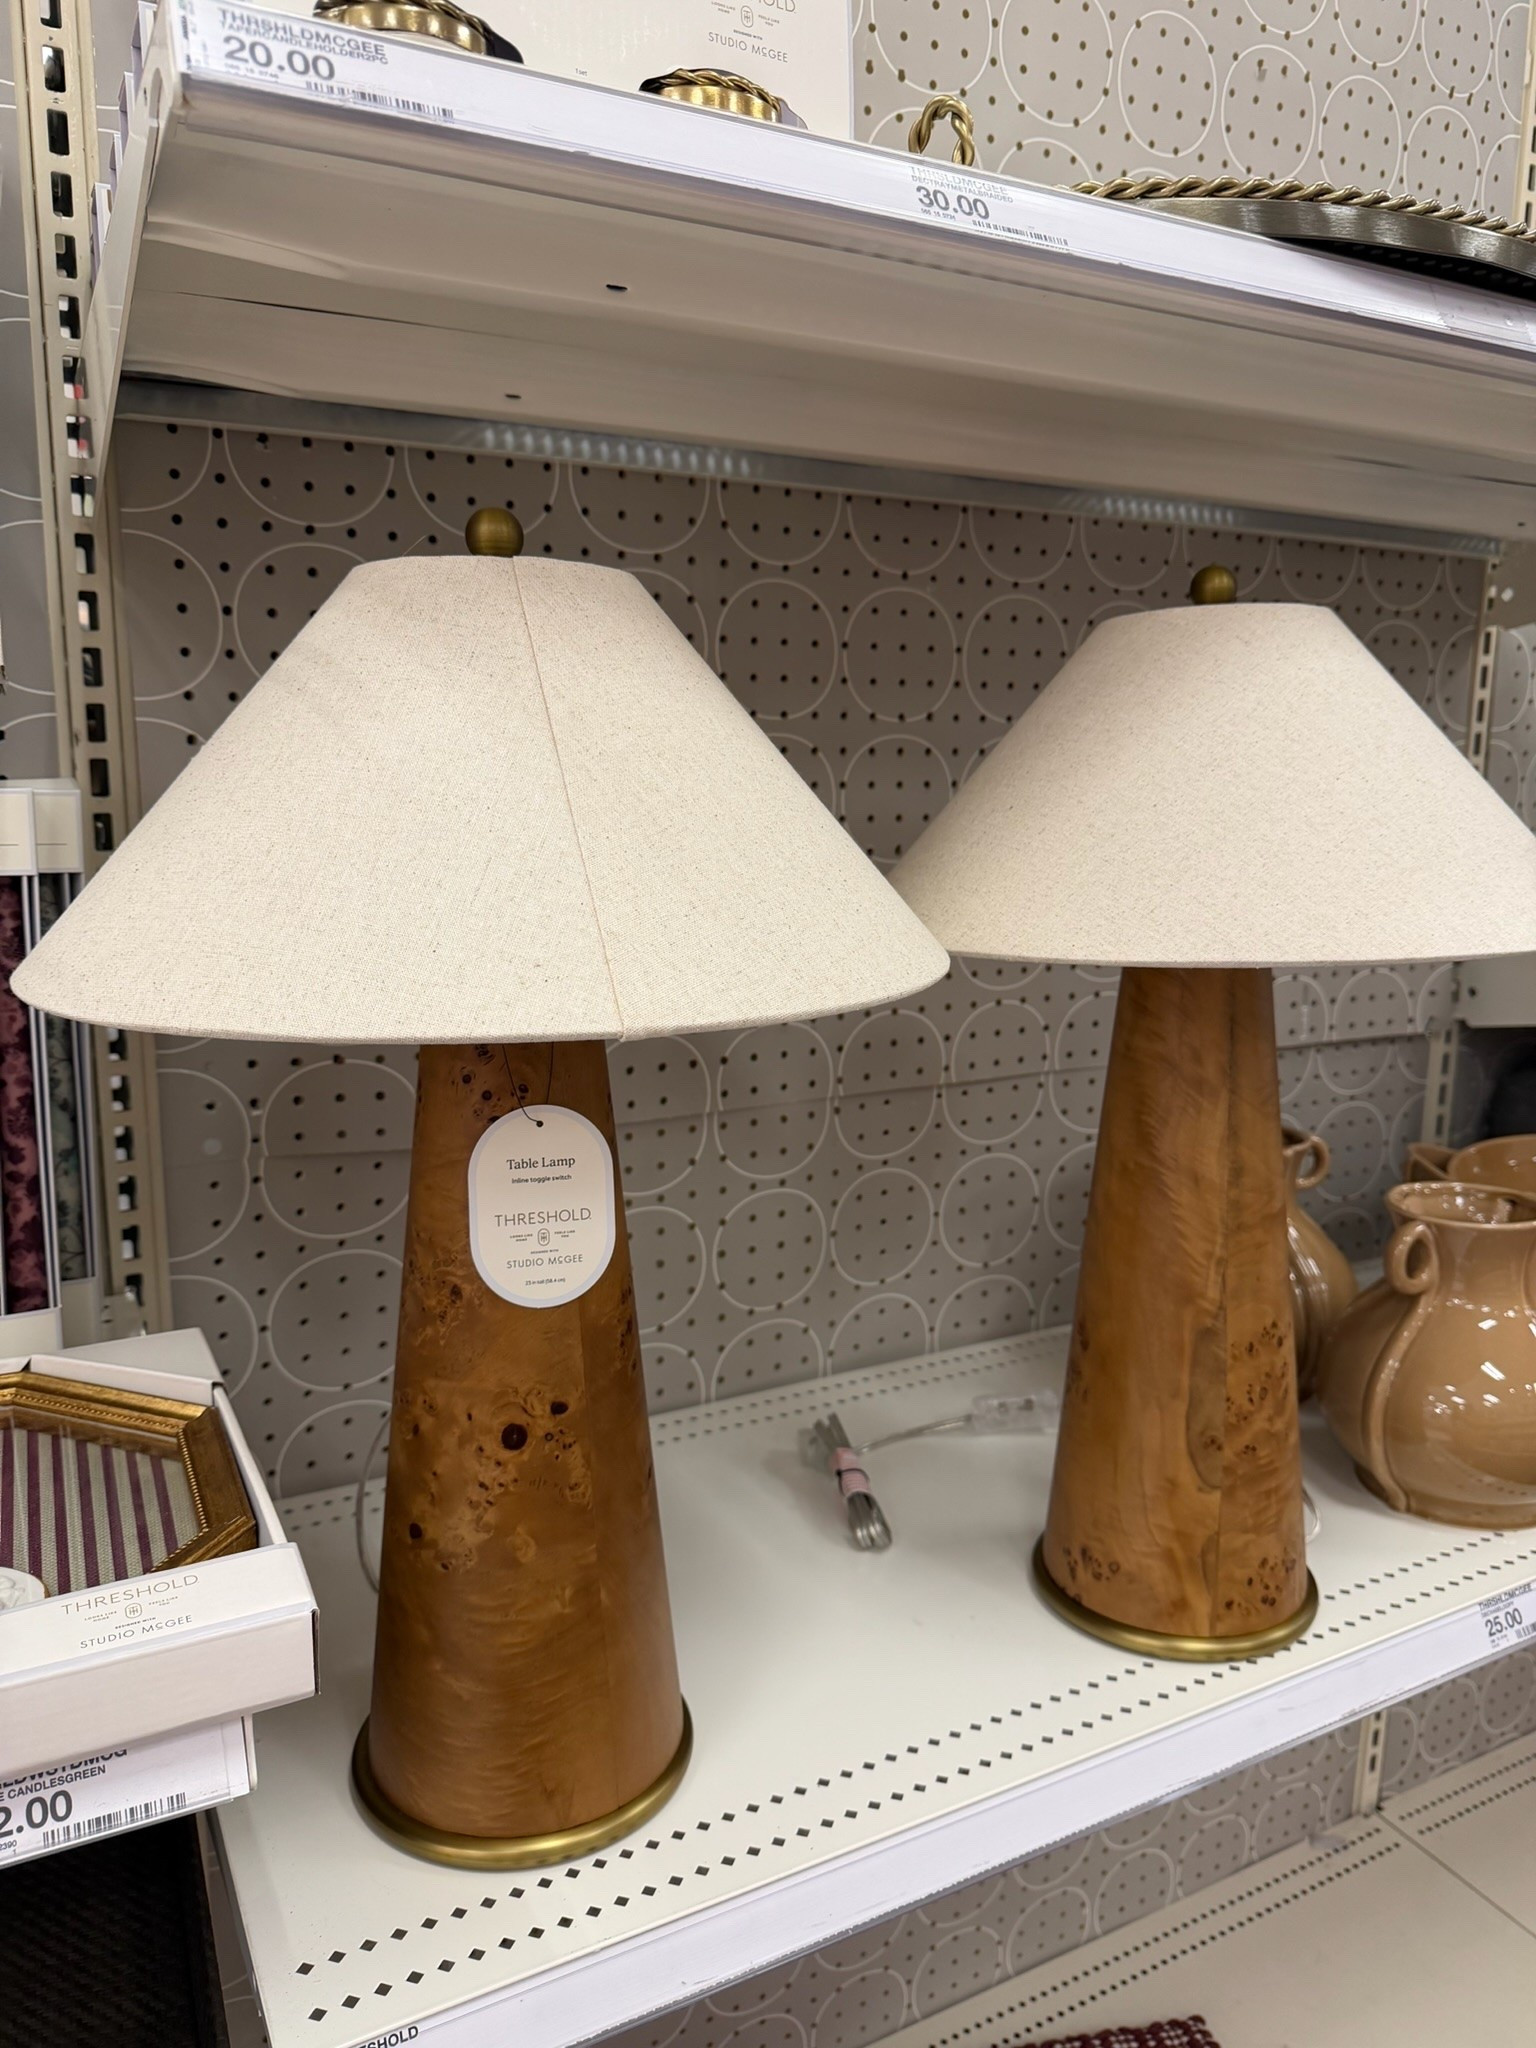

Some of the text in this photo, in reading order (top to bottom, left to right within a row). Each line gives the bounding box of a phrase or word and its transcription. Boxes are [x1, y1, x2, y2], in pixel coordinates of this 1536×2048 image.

[708, 31, 748, 51] STUDIO
[223, 35, 336, 81] 20.00
[916, 185, 990, 220] 30.00
[506, 1157, 576, 1170] Table Lamp
[530, 1175, 551, 1184] toggle
[494, 1207, 591, 1227] THRESHOLD
[506, 1257, 544, 1269] STUDIO
[61, 1574, 199, 1615] THRESHOLD
[1485, 1607, 1523, 1638] 25.00
[80, 1629, 135, 1649] STUDIO
[7, 1764, 106, 1800] CANDLESGREEN
